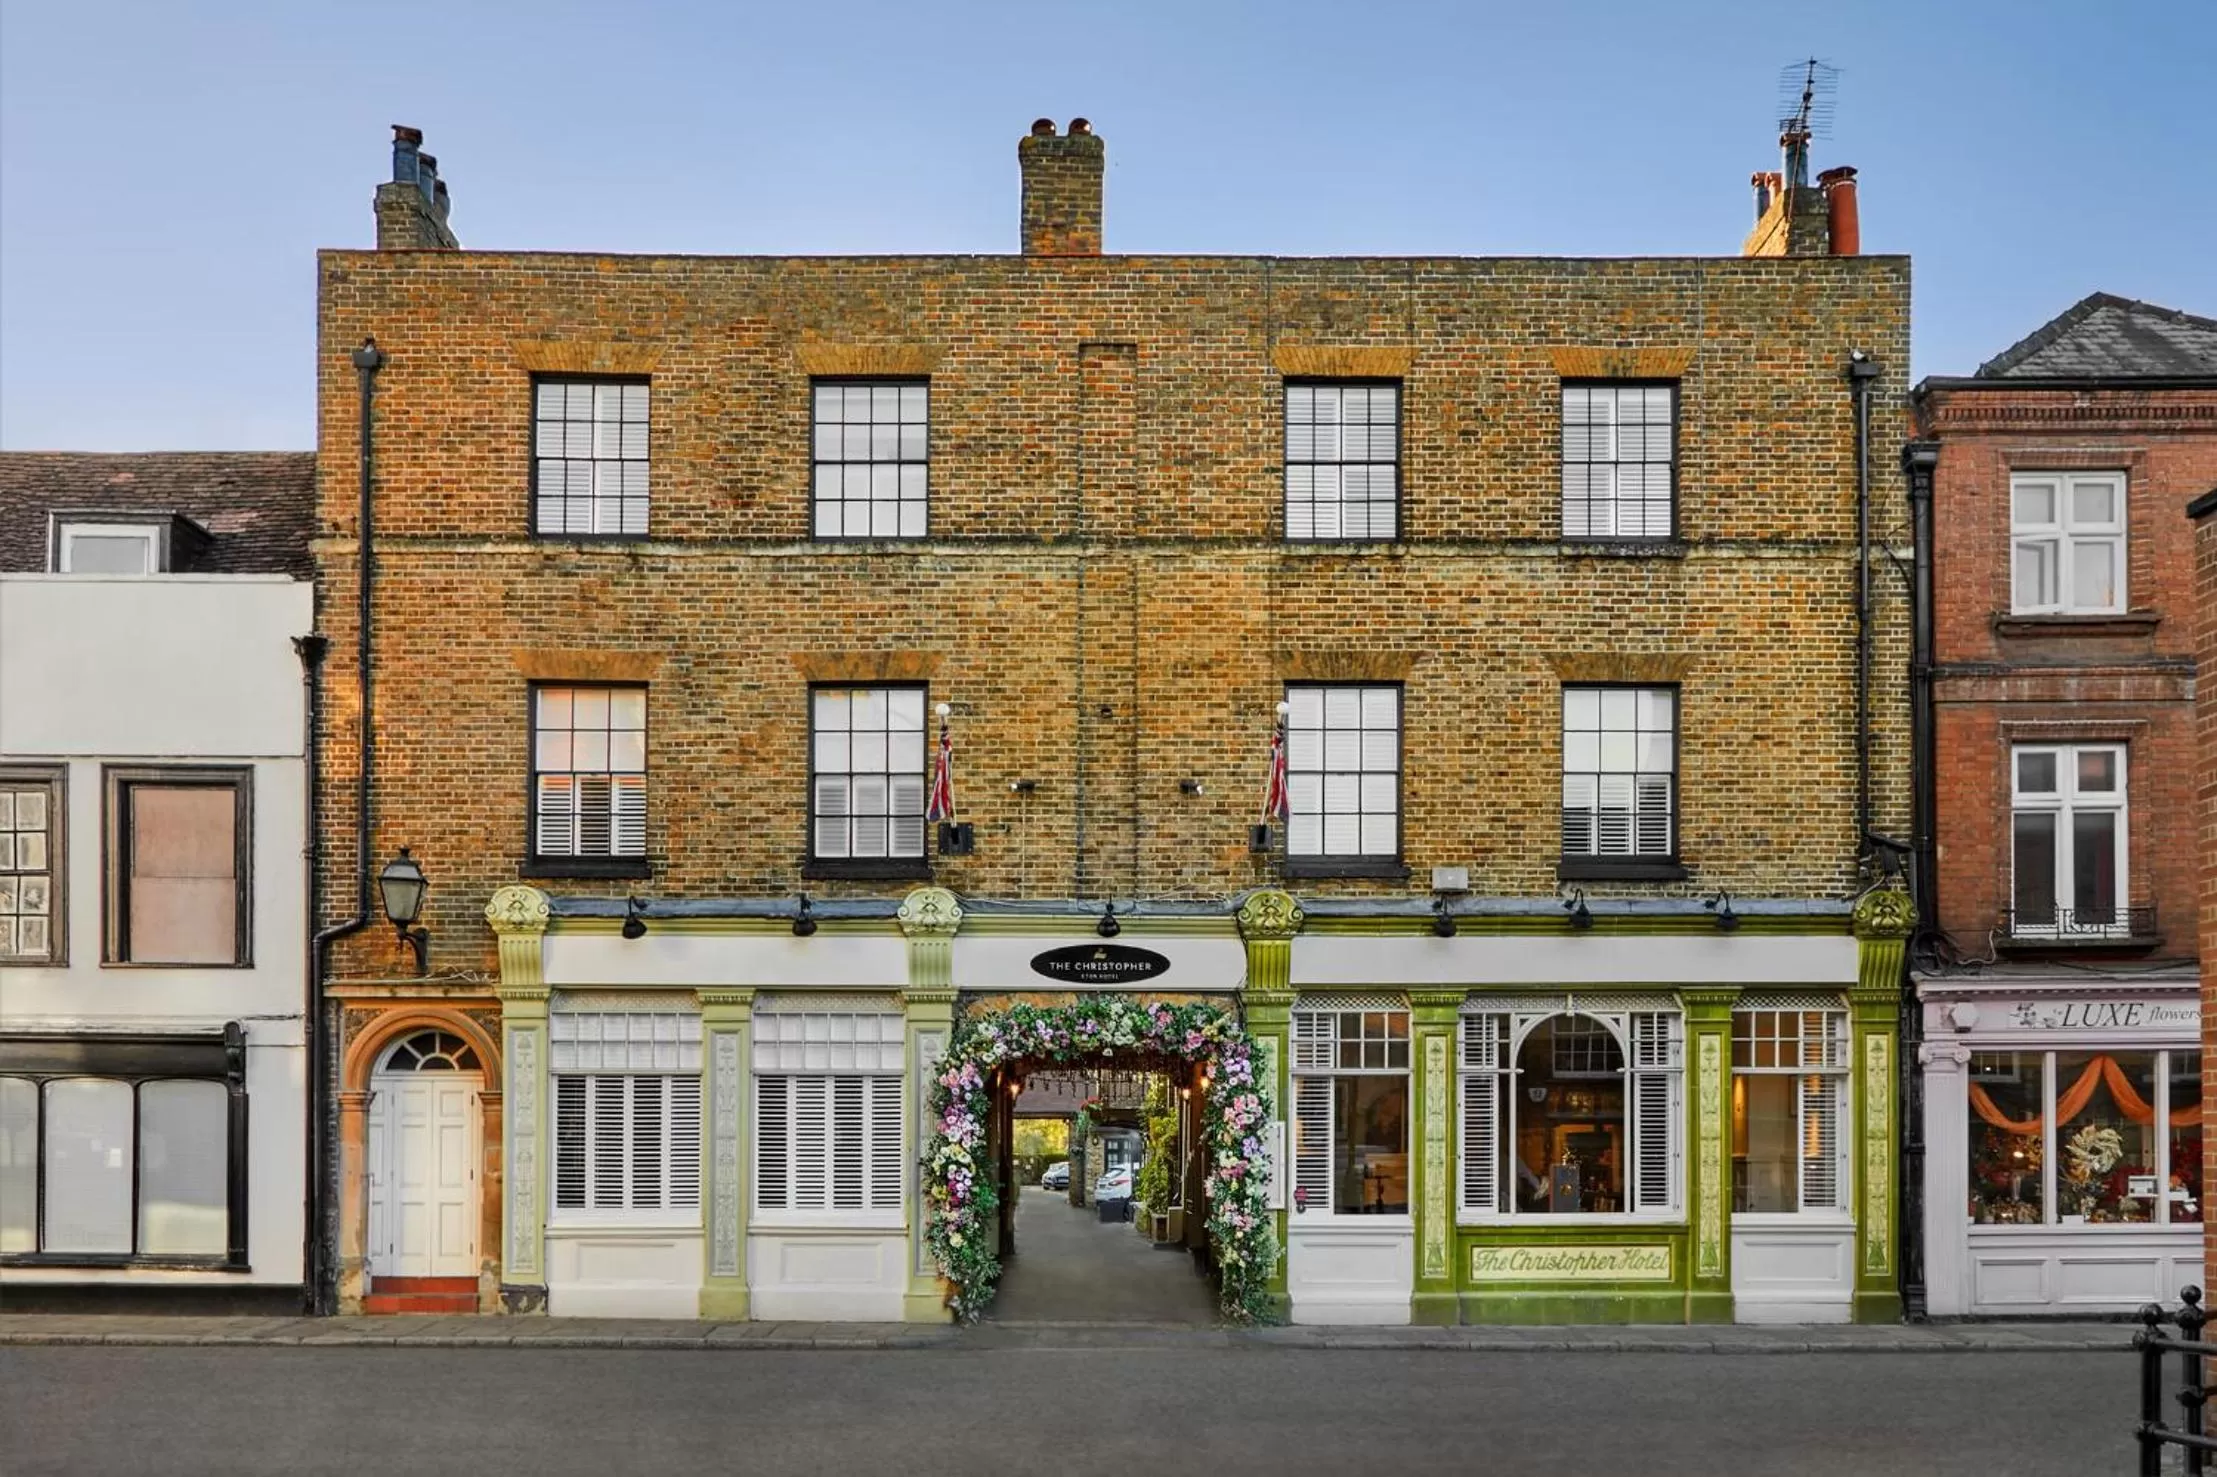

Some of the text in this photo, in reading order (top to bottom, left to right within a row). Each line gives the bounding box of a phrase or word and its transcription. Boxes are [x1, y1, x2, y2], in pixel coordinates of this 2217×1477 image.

[1049, 962, 1152, 971] THE CHRISTOPHER
[2062, 1003, 2144, 1027] LUXE
[1474, 1249, 1669, 1275] The Christopher Hotel
